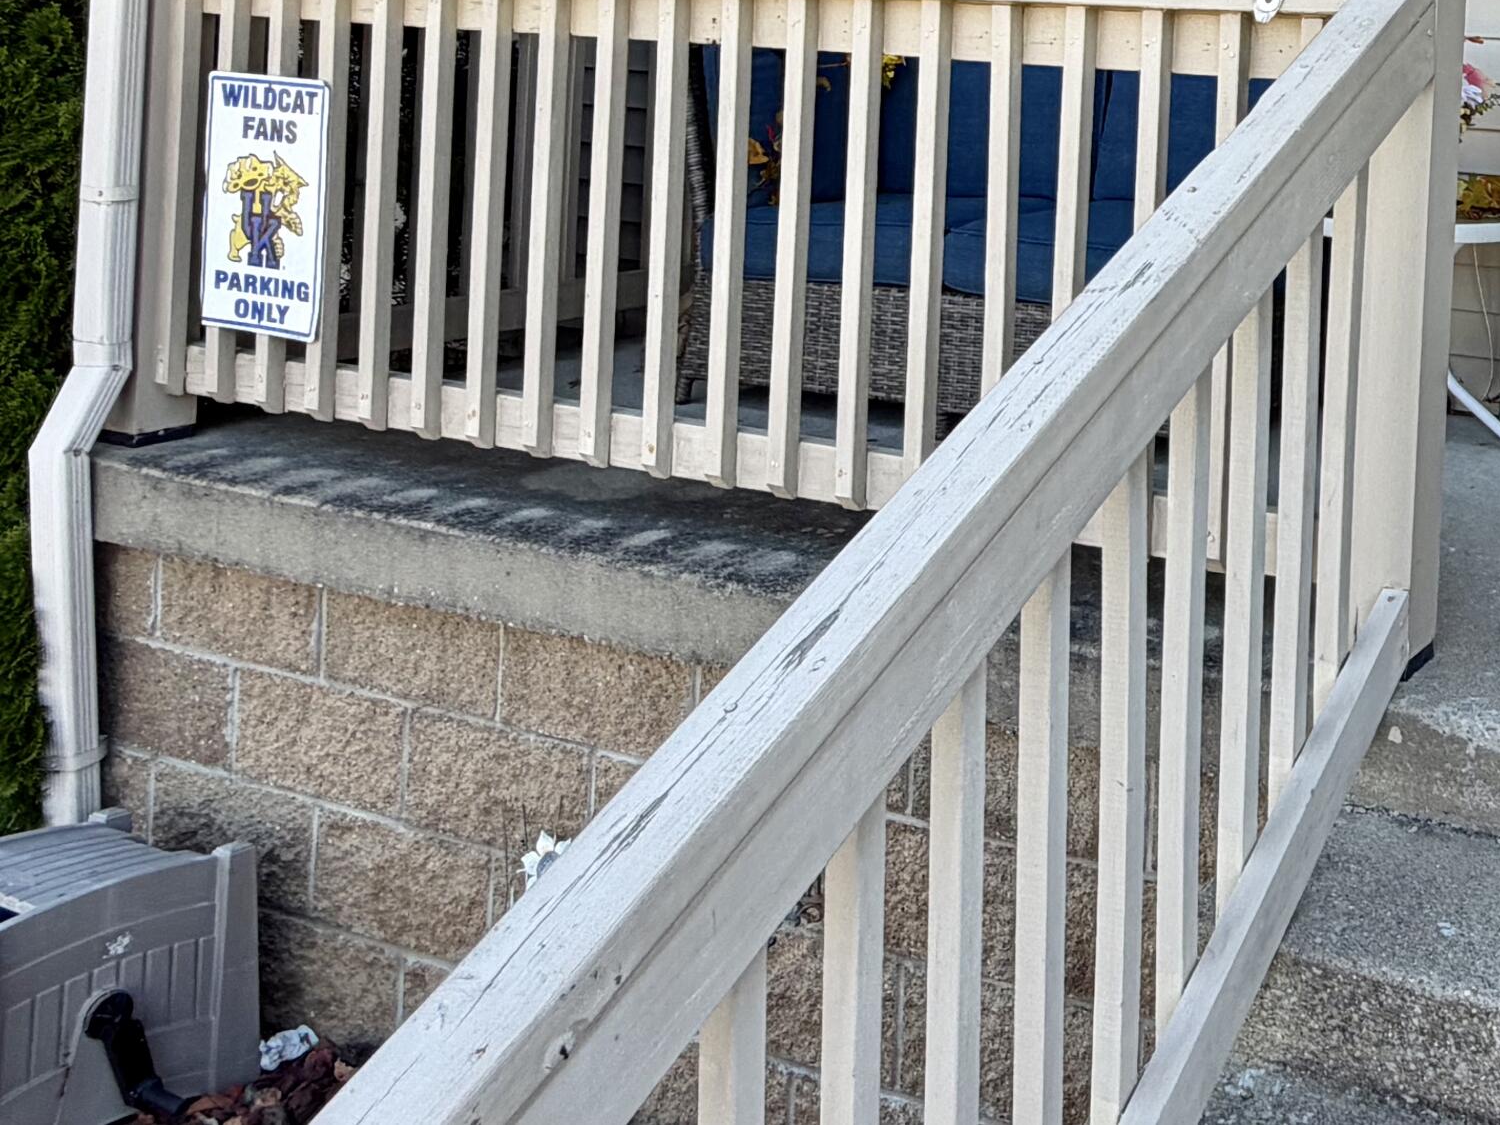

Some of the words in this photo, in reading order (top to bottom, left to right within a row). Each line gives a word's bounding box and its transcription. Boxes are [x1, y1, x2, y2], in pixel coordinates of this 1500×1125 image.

[221, 83, 318, 115] WILDCAT
[242, 116, 298, 144] FANS
[214, 269, 310, 303] PARKING
[234, 297, 290, 324] ONLY
